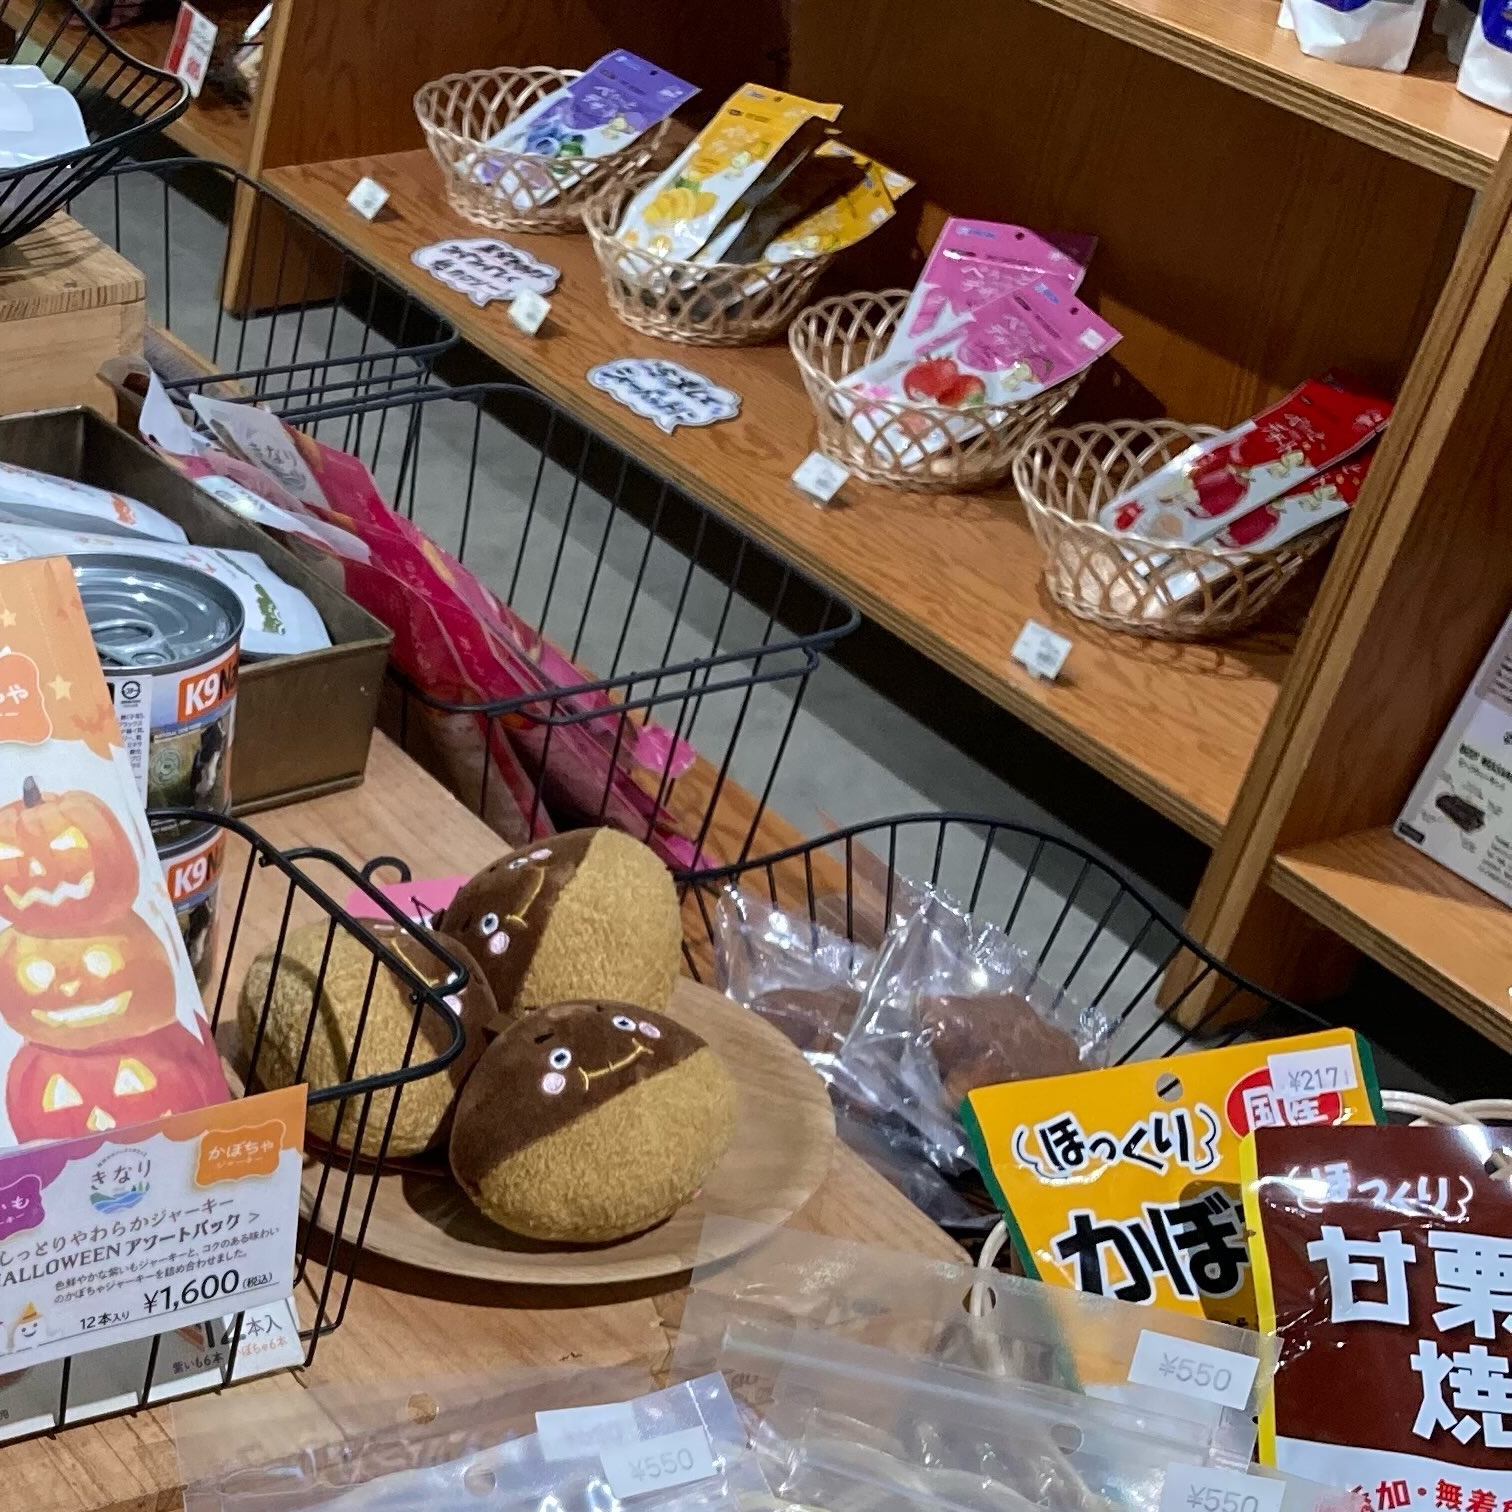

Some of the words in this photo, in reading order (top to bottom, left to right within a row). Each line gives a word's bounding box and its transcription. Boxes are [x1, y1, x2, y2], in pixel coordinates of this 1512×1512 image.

[1287, 1066, 1339, 1092] ¥217
[208, 1138, 274, 1161] かぼちゃ
[1039, 1111, 1197, 1175] ほっくり
[91, 1159, 152, 1191] きなり
[0, 1197, 235, 1267] しっとりやわらかジャーキー
[127, 1213, 241, 1258] アソートパック
[1054, 1188, 1256, 1304] かぼ
[80, 1310, 130, 1330] 12本入り
[143, 1269, 240, 1313] ¥1,600
[242, 1271, 274, 1290] (税込)
[1307, 1224, 1512, 1341] 甘栗
[172, 1352, 225, 1375] 紫いも6本
[1158, 1351, 1233, 1392] ¥550
[627, 1447, 694, 1482] ¥550
